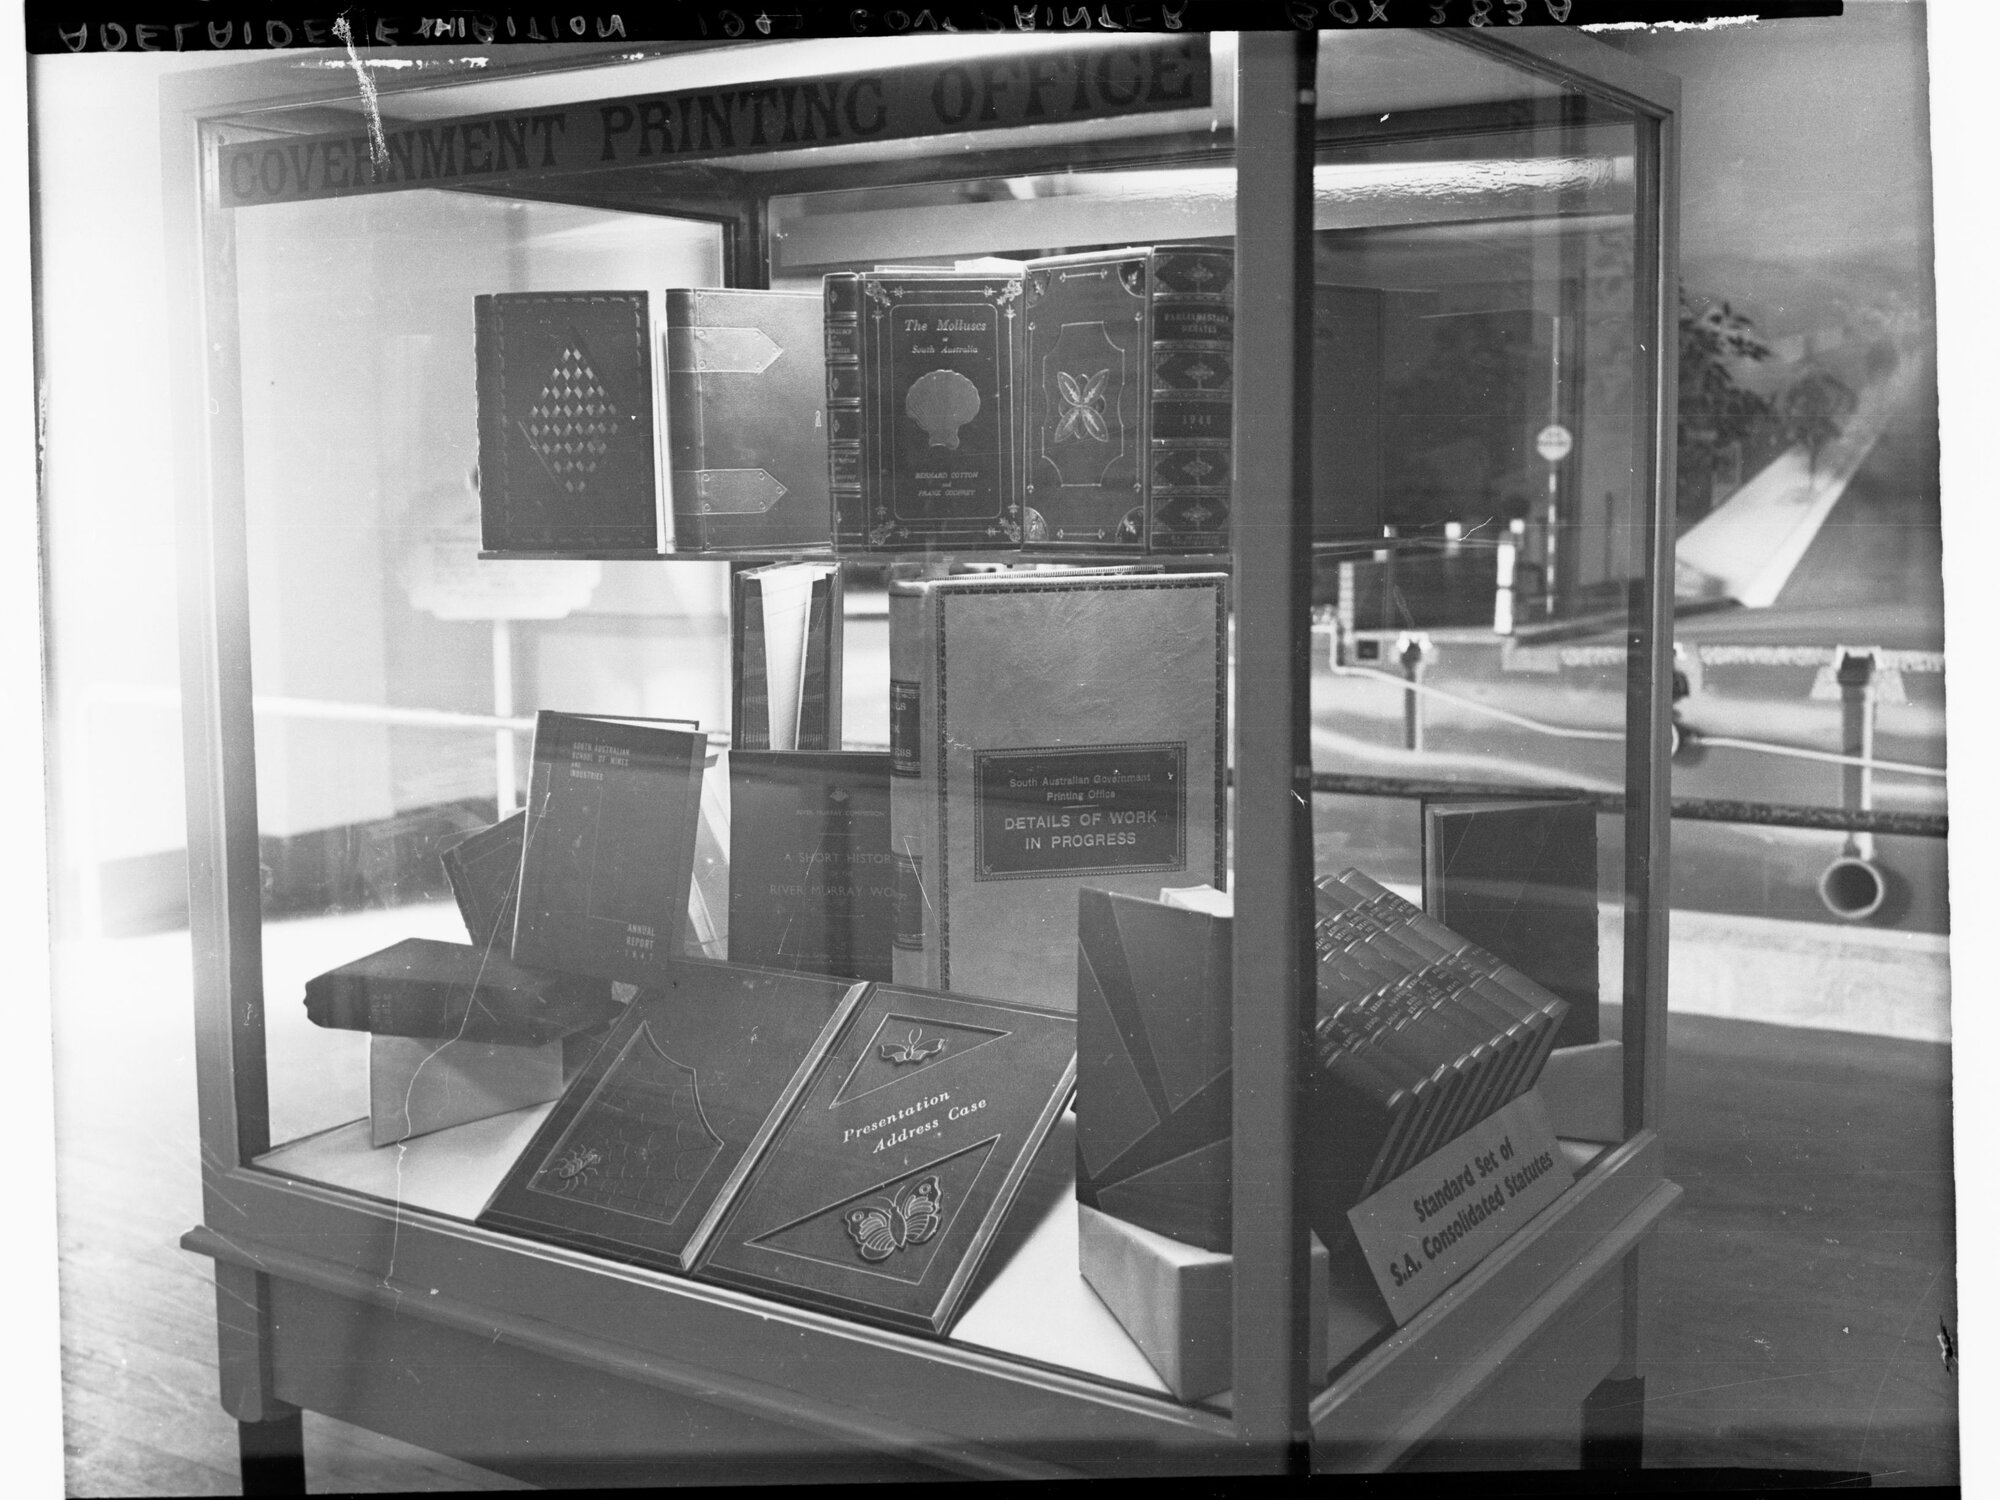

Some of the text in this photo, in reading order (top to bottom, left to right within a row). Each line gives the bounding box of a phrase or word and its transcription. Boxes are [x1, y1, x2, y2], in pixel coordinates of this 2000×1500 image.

[229, 40, 1195, 200] GOVERNMENT PRINTING OFFICE
[904, 318, 987, 332] The Molluscs
[911, 344, 979, 354] South Australia
[950, 471, 979, 479] COTTON
[594, 744, 630, 756] AUSTRALIAN
[570, 769, 603, 781] INDUSTRIES
[1009, 772, 1151, 788] South Australian Government
[1046, 789, 1116, 802] Printing Office
[1004, 810, 1157, 831] DETAILS OF WORK
[1025, 831, 1137, 850] IN PROGRESS
[783, 853, 891, 865] A SHORT HISTOR
[769, 884, 803, 897] RIVER
[811, 885, 864, 897] MURRAY
[627, 923, 655, 937] ANNUAL
[626, 935, 655, 950] REPORT
[843, 1091, 950, 1143] Presentation
[872, 1099, 987, 1154] Address Case
[1413, 1136, 1515, 1223] Standard Set of
[1389, 1151, 1554, 1288] S.A. Consolidated Statutes
